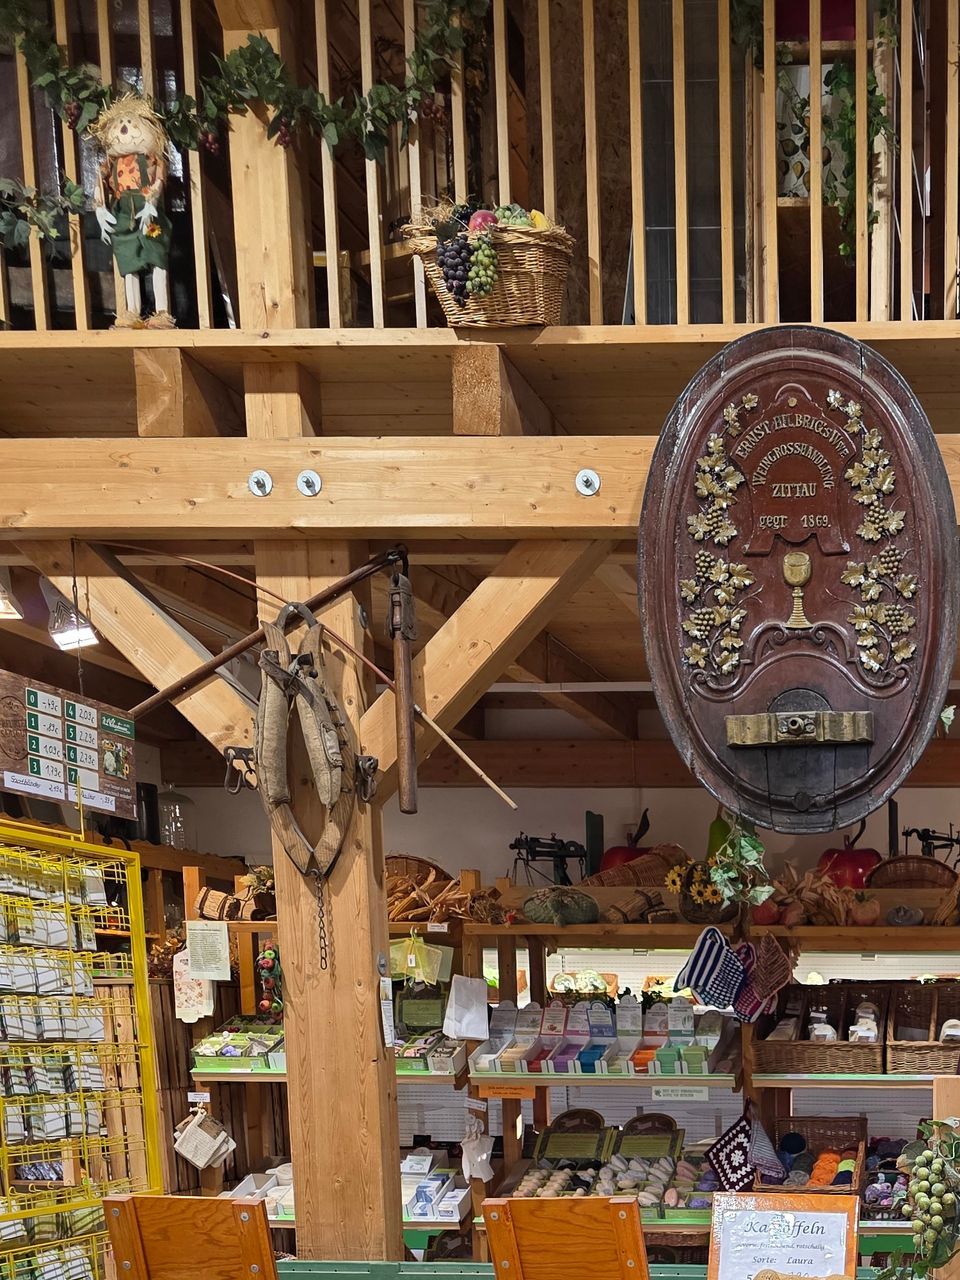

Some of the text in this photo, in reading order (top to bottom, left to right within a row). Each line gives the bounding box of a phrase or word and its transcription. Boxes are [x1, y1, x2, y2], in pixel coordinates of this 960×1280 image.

[736, 420, 771, 459] ERNST
[752, 442, 835, 489] WEINGROSSHANDLUNG
[771, 483, 817, 497] ZITTAU
[30, 694, 34, 703] 0
[69, 707, 73, 715] 4
[31, 718, 35, 726] 1
[69, 728, 74, 737] 5
[32, 740, 36, 749] 2
[70, 750, 74, 758] 6
[33, 764, 37, 772] 3
[744, 1220, 826, 1238] Kaoffeln
[752, 1256, 814, 1265] Sorte: Laura
